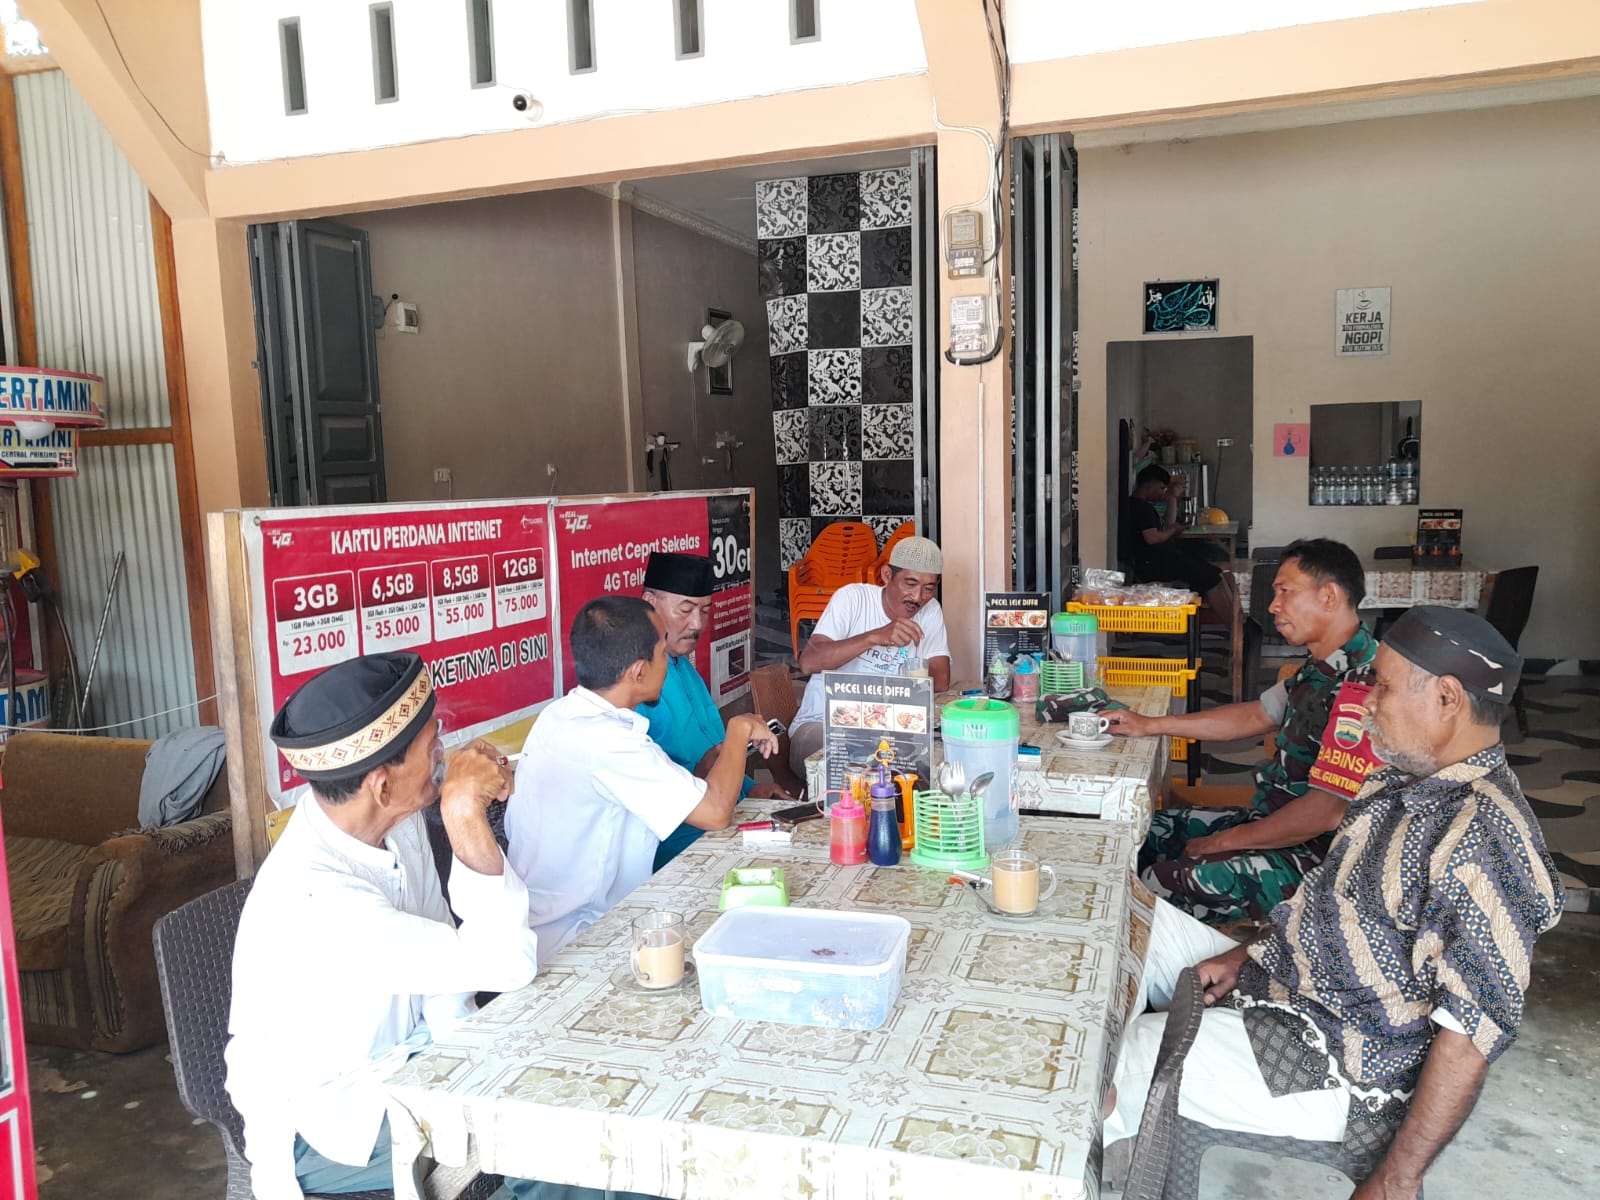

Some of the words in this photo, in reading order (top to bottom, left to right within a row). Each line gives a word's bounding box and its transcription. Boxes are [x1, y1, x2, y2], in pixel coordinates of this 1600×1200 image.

[1346, 311, 1382, 324] KERJA
[1344, 331, 1382, 345] NGOPI
[331, 527, 380, 555] KARTU
[383, 522, 446, 550] PERDANA
[447, 519, 502, 543] INTERNET
[571, 543, 623, 569] Internet
[625, 539, 659, 563] Cepat
[661, 533, 700, 553] Sekelas
[443, 564, 479, 591] 8,5GB
[502, 556, 538, 579] 12GB
[372, 573, 414, 602] 6,5GB
[604, 573, 620, 592] 4G
[294, 583, 339, 612] 3GB
[505, 593, 539, 613] 75.000
[445, 602, 484, 625] 55.000
[375, 615, 420, 639] 35.000
[293, 629, 346, 656] 23.000
[426, 648, 498, 690] KETNYA
[500, 641, 517, 669] DI
[520, 633, 549, 663] SINI
[834, 682, 861, 694] PECEL
[863, 684, 883, 696] LELE
[884, 685, 911, 698] DIFFA
[1318, 745, 1374, 776] BABINSA
